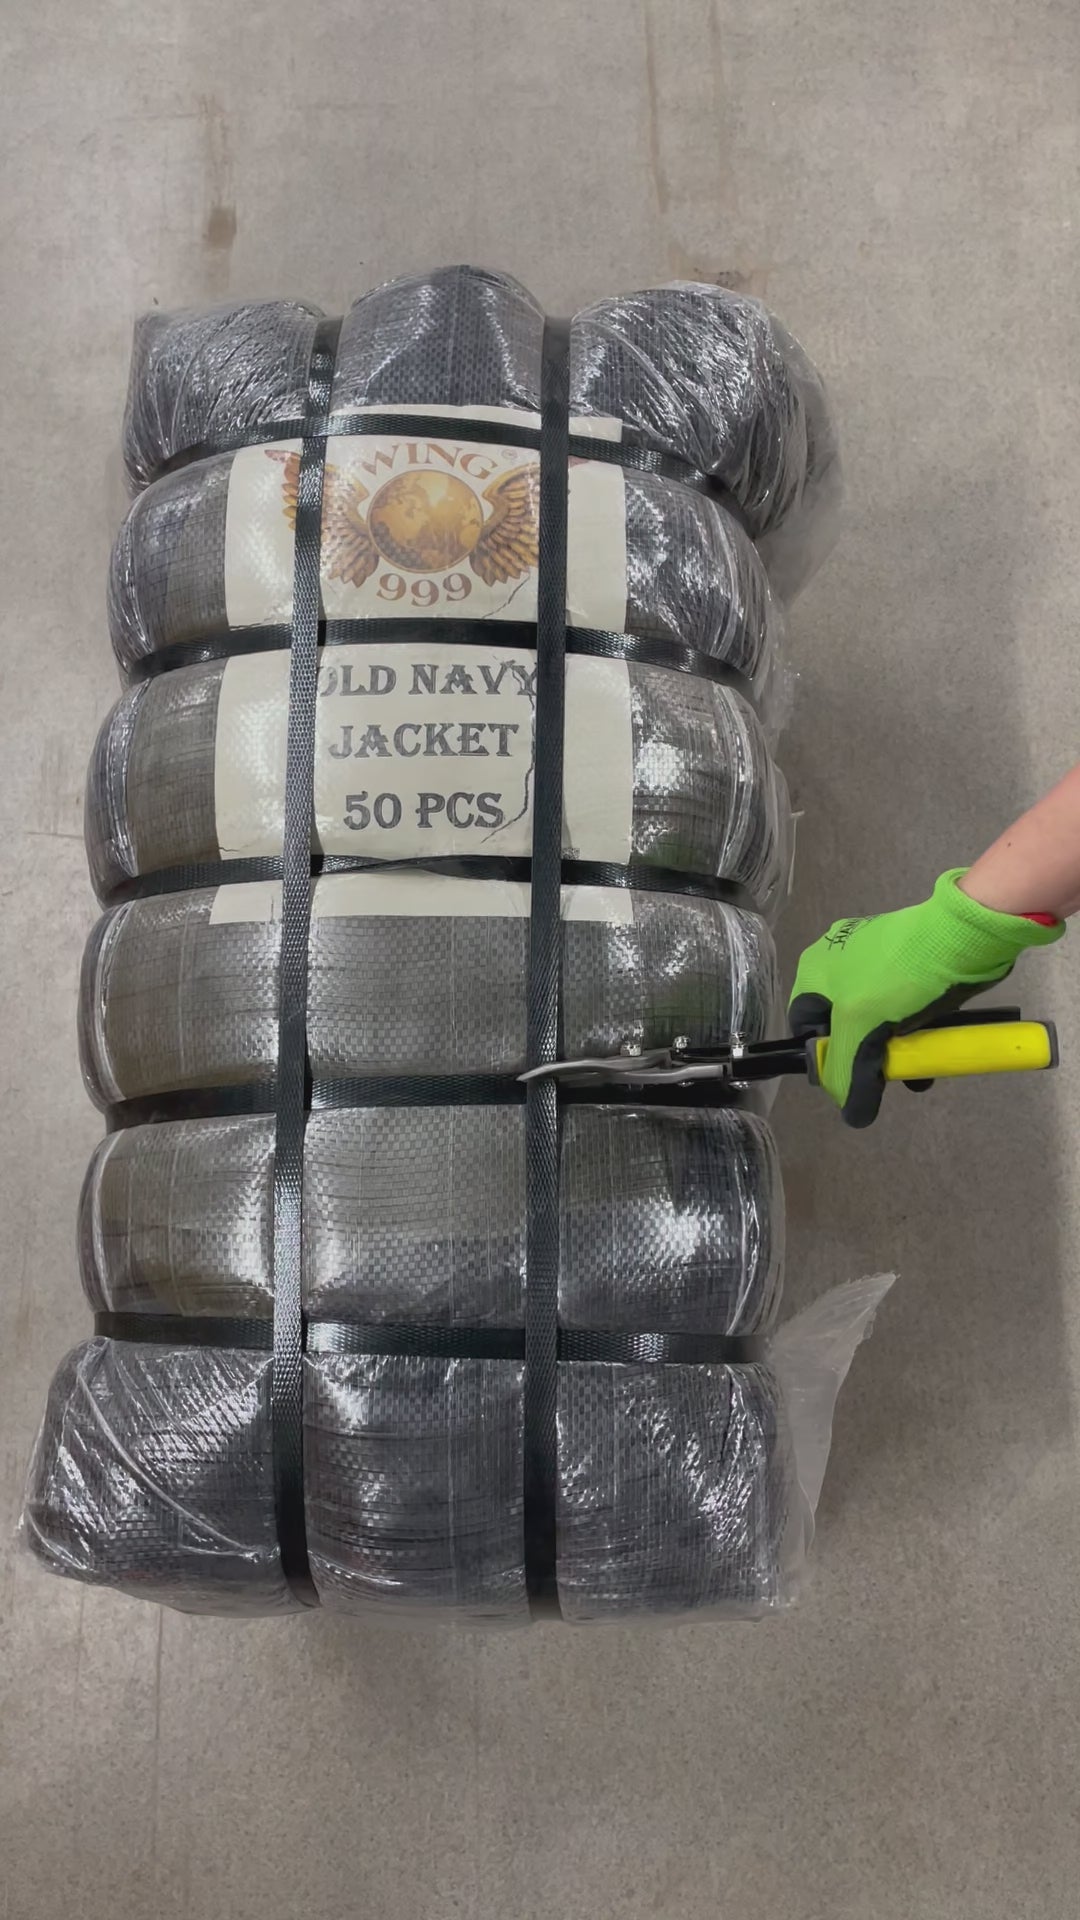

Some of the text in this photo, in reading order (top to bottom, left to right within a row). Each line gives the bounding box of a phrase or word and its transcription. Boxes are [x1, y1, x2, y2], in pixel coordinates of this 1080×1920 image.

[361, 442, 499, 480] WING
[376, 572, 473, 608] 999
[407, 662, 538, 697] NAVY
[328, 722, 520, 760] JACKET
[343, 790, 505, 831] 50 PCS
